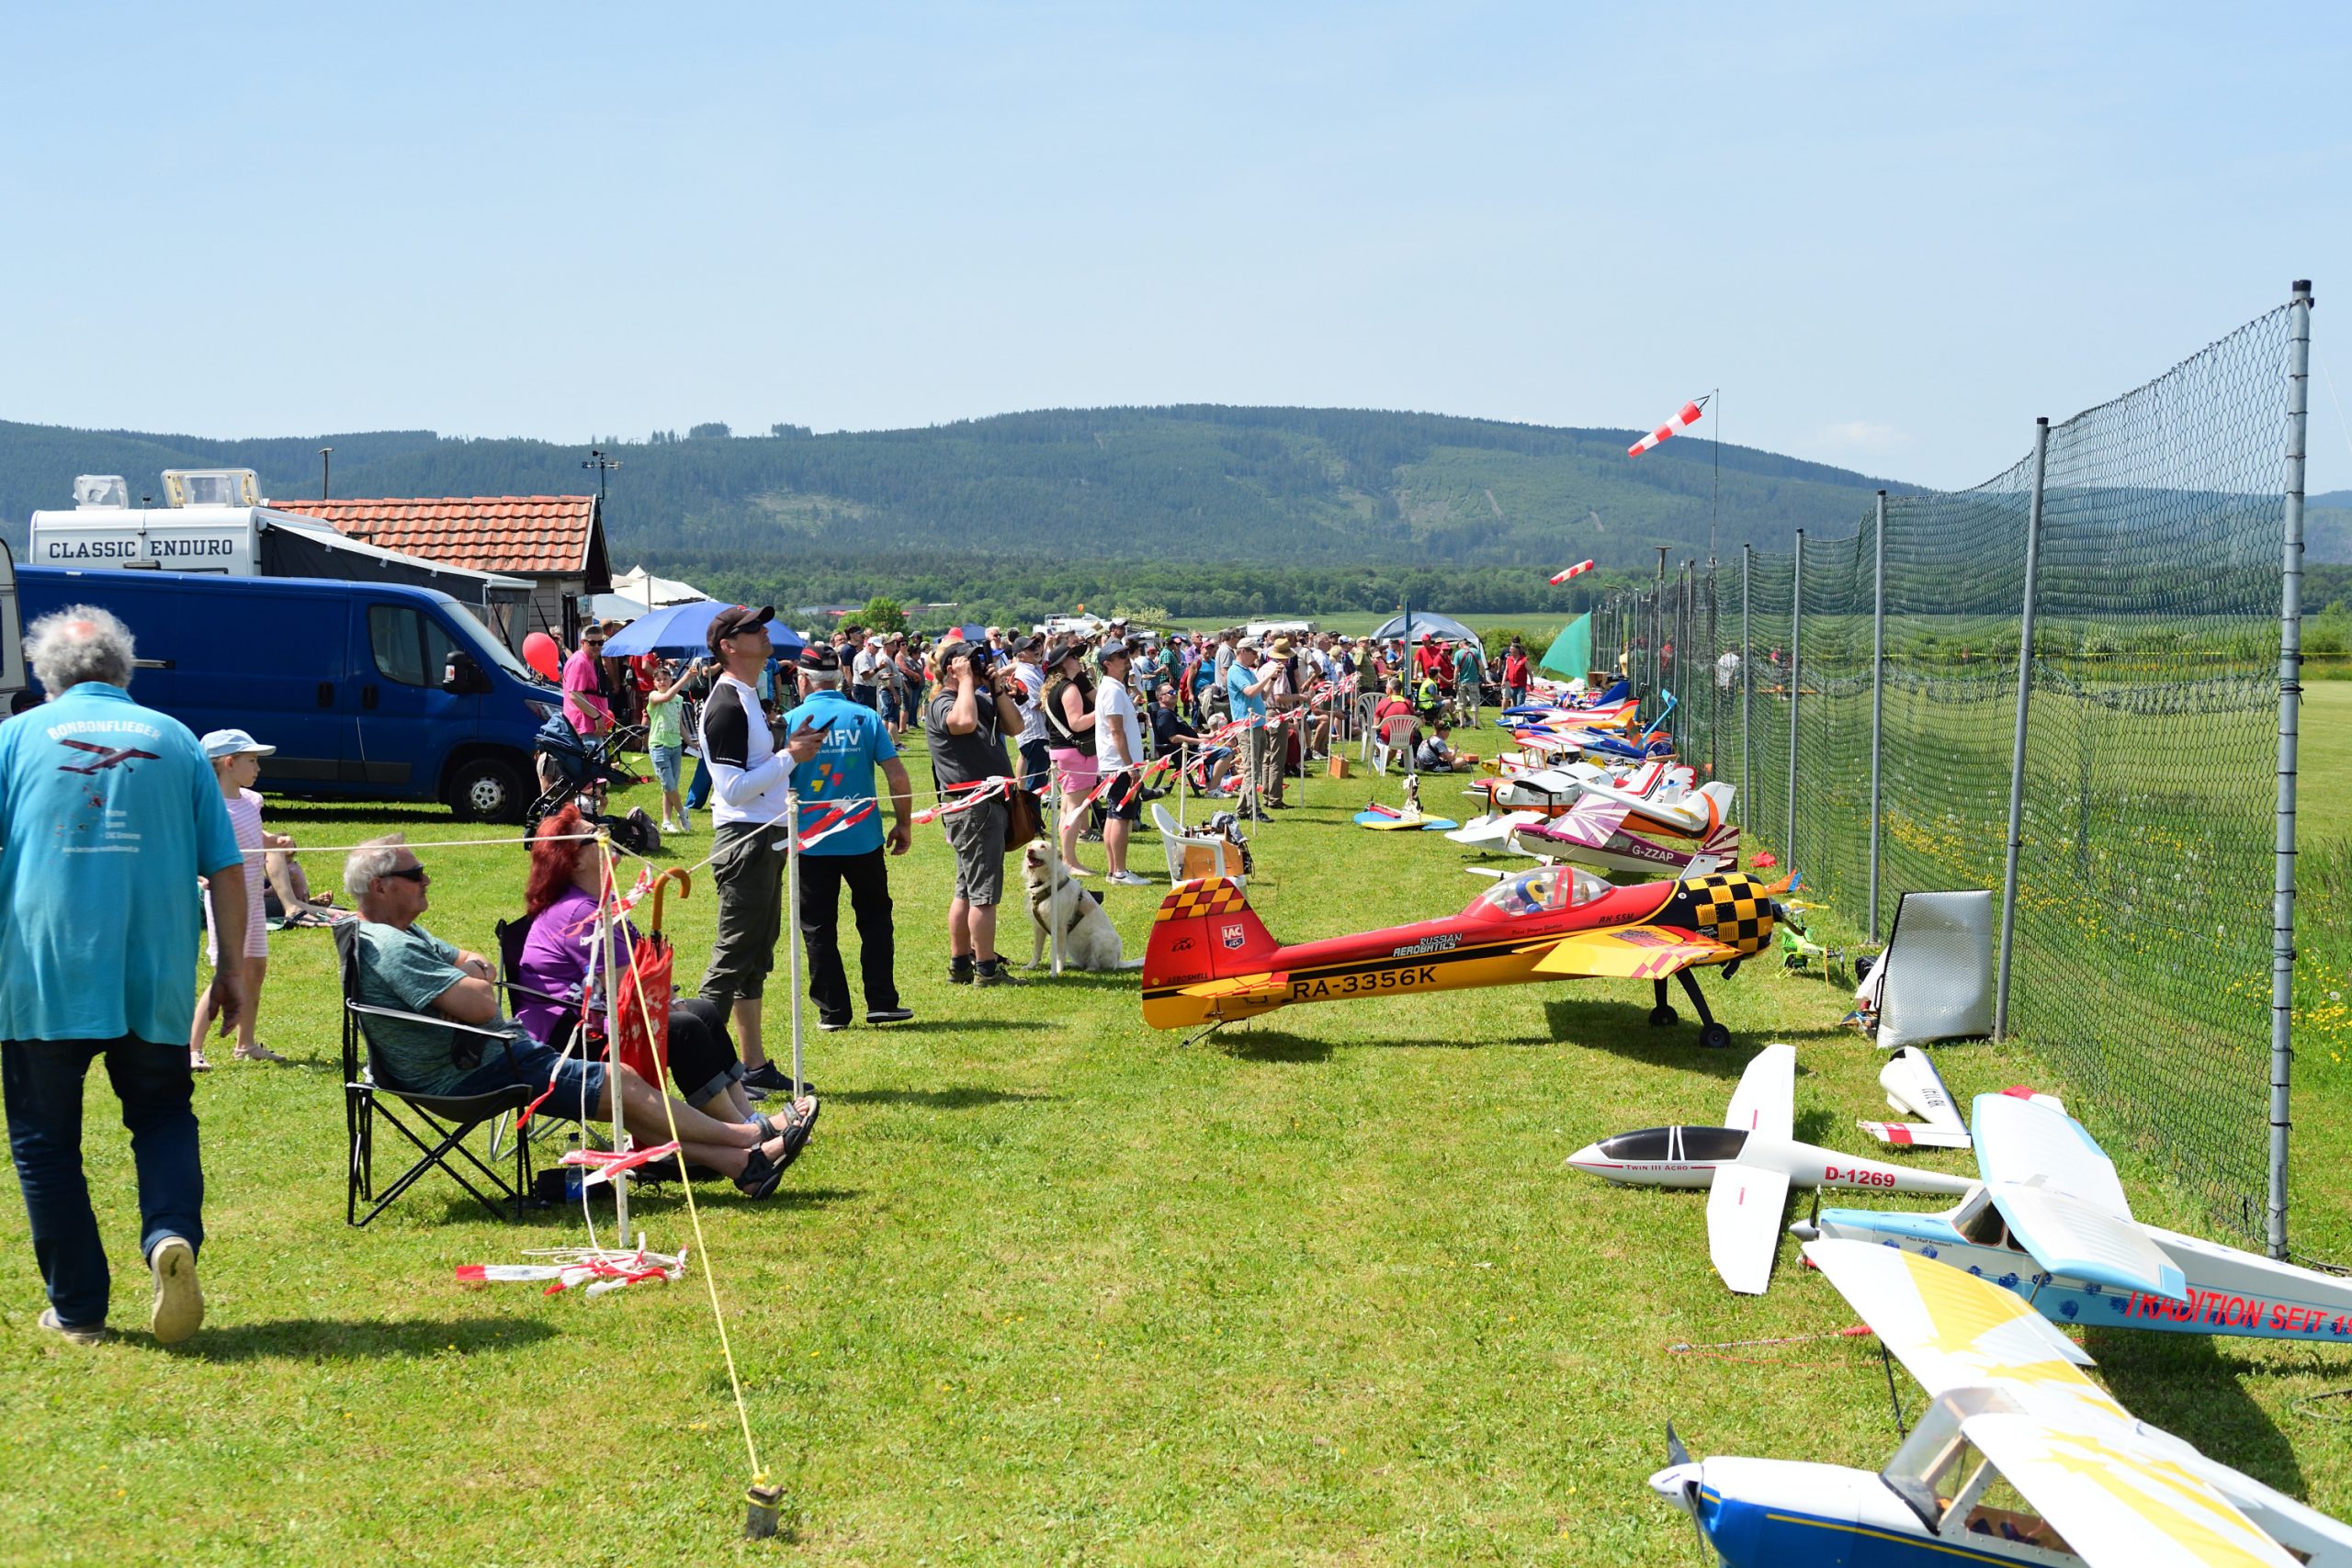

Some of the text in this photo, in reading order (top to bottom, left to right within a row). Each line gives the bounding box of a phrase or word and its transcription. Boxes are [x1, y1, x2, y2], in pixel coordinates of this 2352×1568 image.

[49, 539, 233, 558] CLASSIC ENDURO
[47, 720, 162, 741] BONBONFLIEGER
[1632, 845, 1674, 863] G-ZZAP
[1223, 926, 1242, 939] IAC
[1419, 933, 1462, 946] RUSSIAN
[1393, 942, 1456, 957] AEROBATICS
[1293, 966, 1437, 999] RA-3356K
[1825, 1167, 1895, 1188] D-1269
[2124, 1288, 2266, 1327] TRADITION
[2268, 1304, 2328, 1332] SEIT
